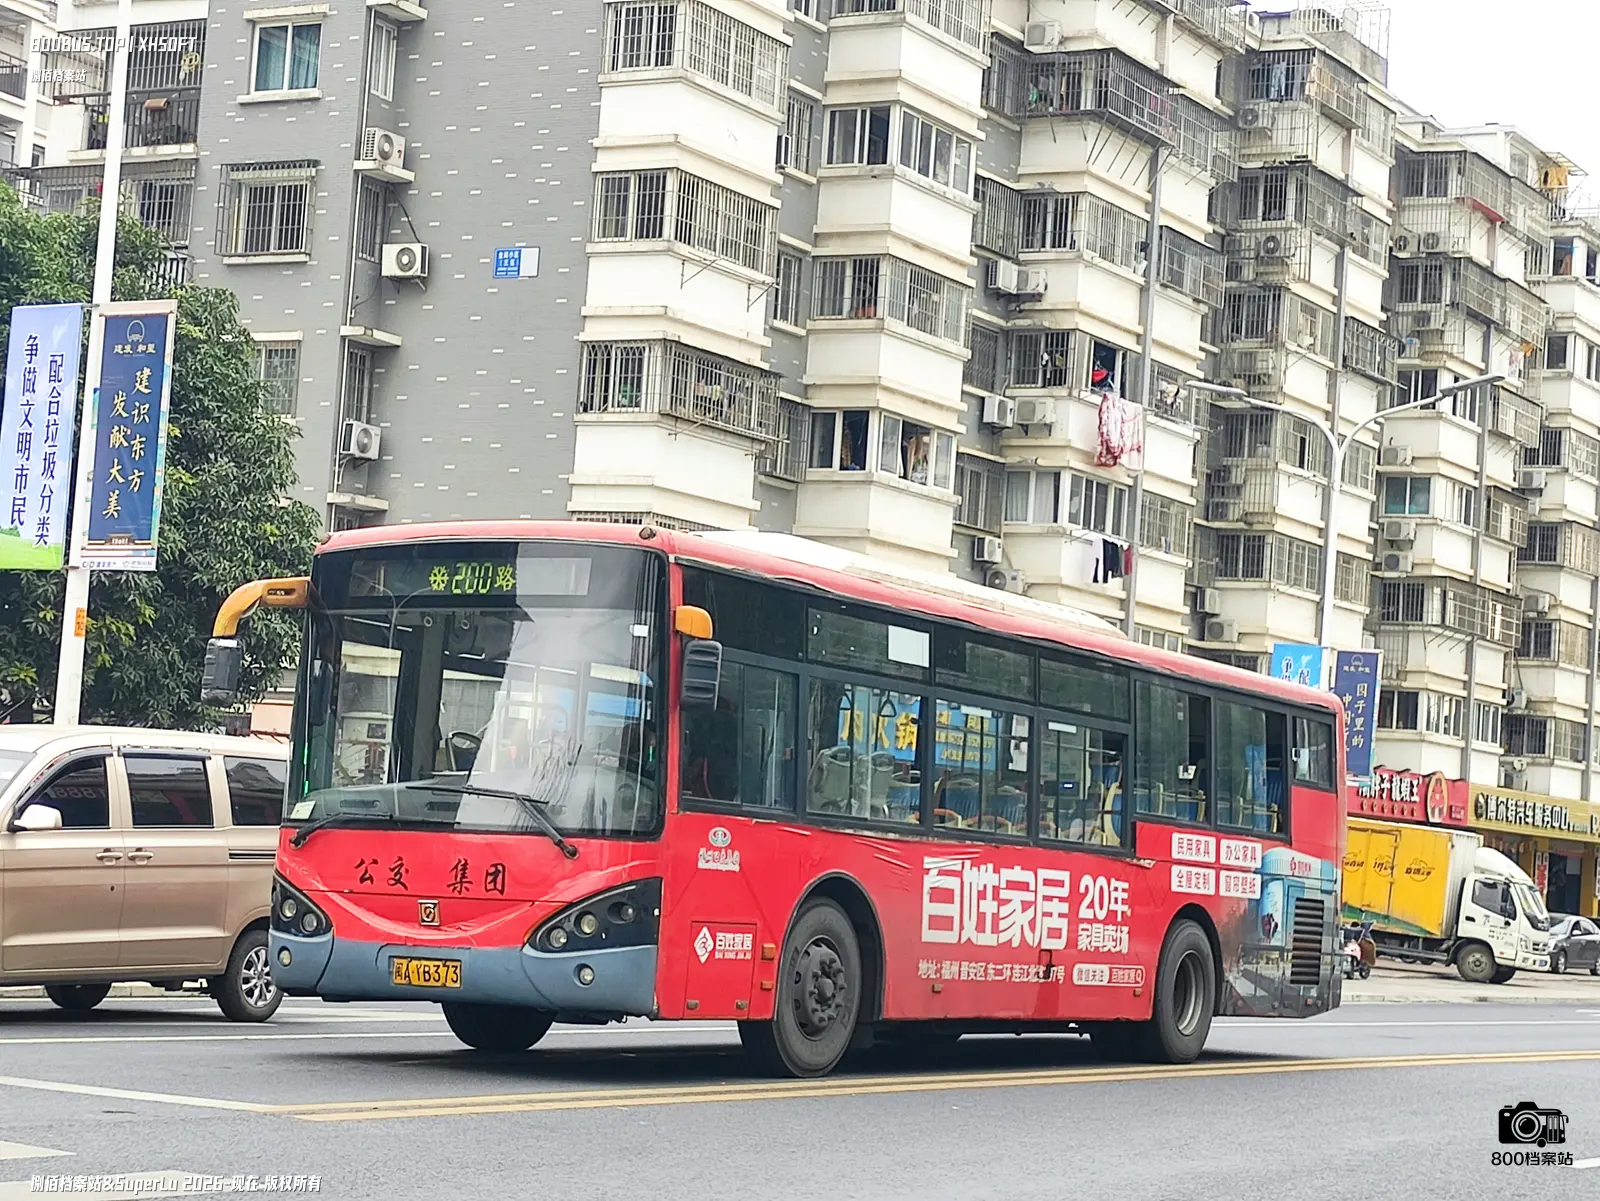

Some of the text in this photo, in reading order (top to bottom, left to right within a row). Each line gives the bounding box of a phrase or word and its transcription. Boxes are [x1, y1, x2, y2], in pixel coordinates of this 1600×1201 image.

[9, 333, 40, 527] 争做文明市民
[34, 353, 64, 546] 配合垃圾分类
[127, 366, 153, 493] 建识东方
[102, 390, 130, 520] 发献大美
[451, 562, 516, 594] 200路
[1177, 837, 1211, 858] 民用家具
[1225, 844, 1258, 865] 办公家具
[354, 856, 507, 896] 公交 集团
[1176, 869, 1211, 891] 全屋定制
[922, 856, 1071, 950] 百姓家居
[1078, 874, 1129, 922] 20年
[715, 932, 753, 950] 百姓家居
[1078, 922, 1129, 954] 家具卖场
